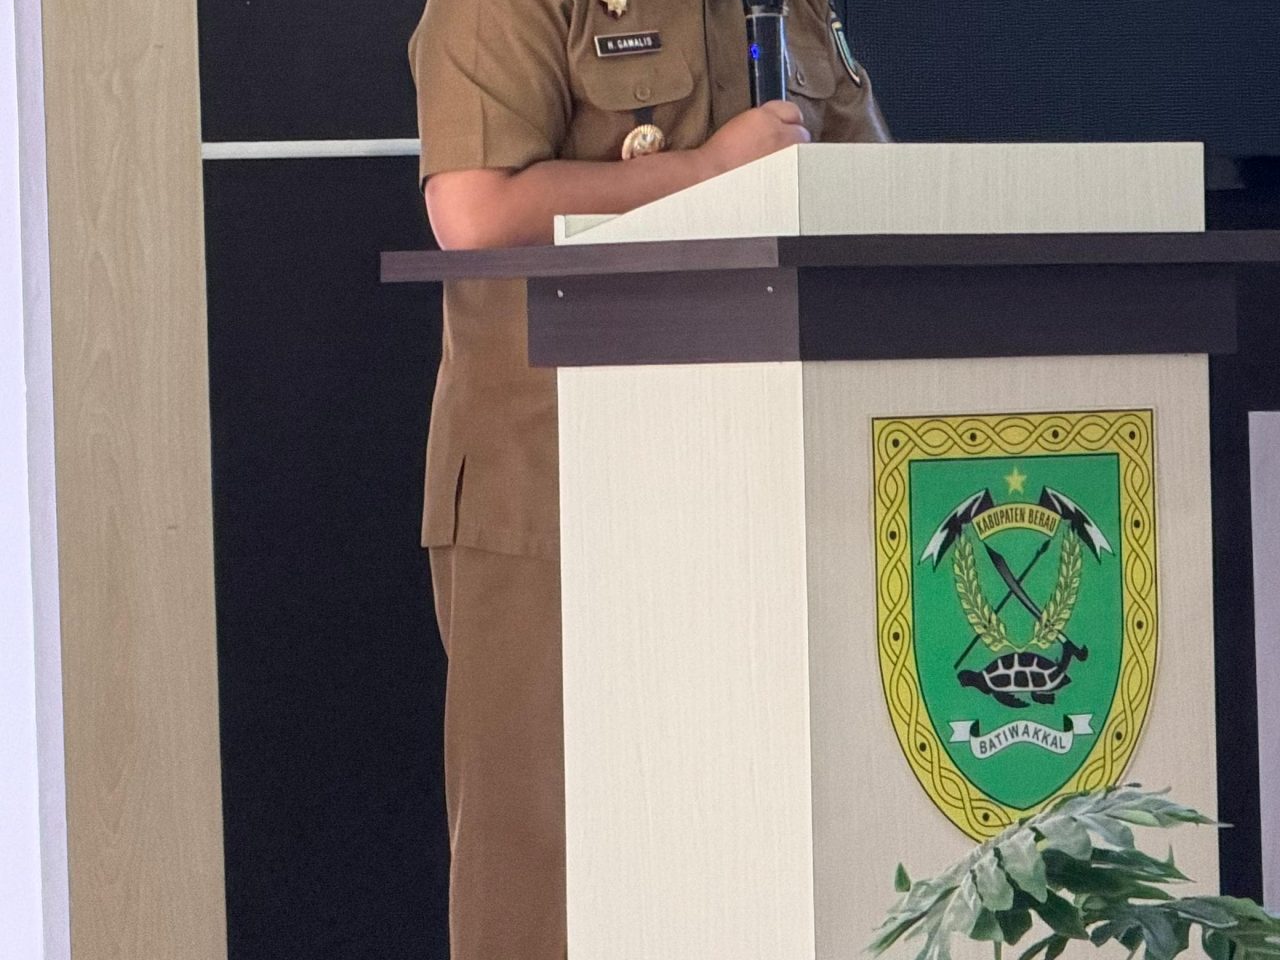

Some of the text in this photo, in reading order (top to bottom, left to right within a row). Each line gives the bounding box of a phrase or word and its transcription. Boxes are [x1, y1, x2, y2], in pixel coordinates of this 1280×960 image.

[976, 506, 1058, 534] KABUPATEN BERAU
[979, 723, 1067, 755] BATIWAKKAL
